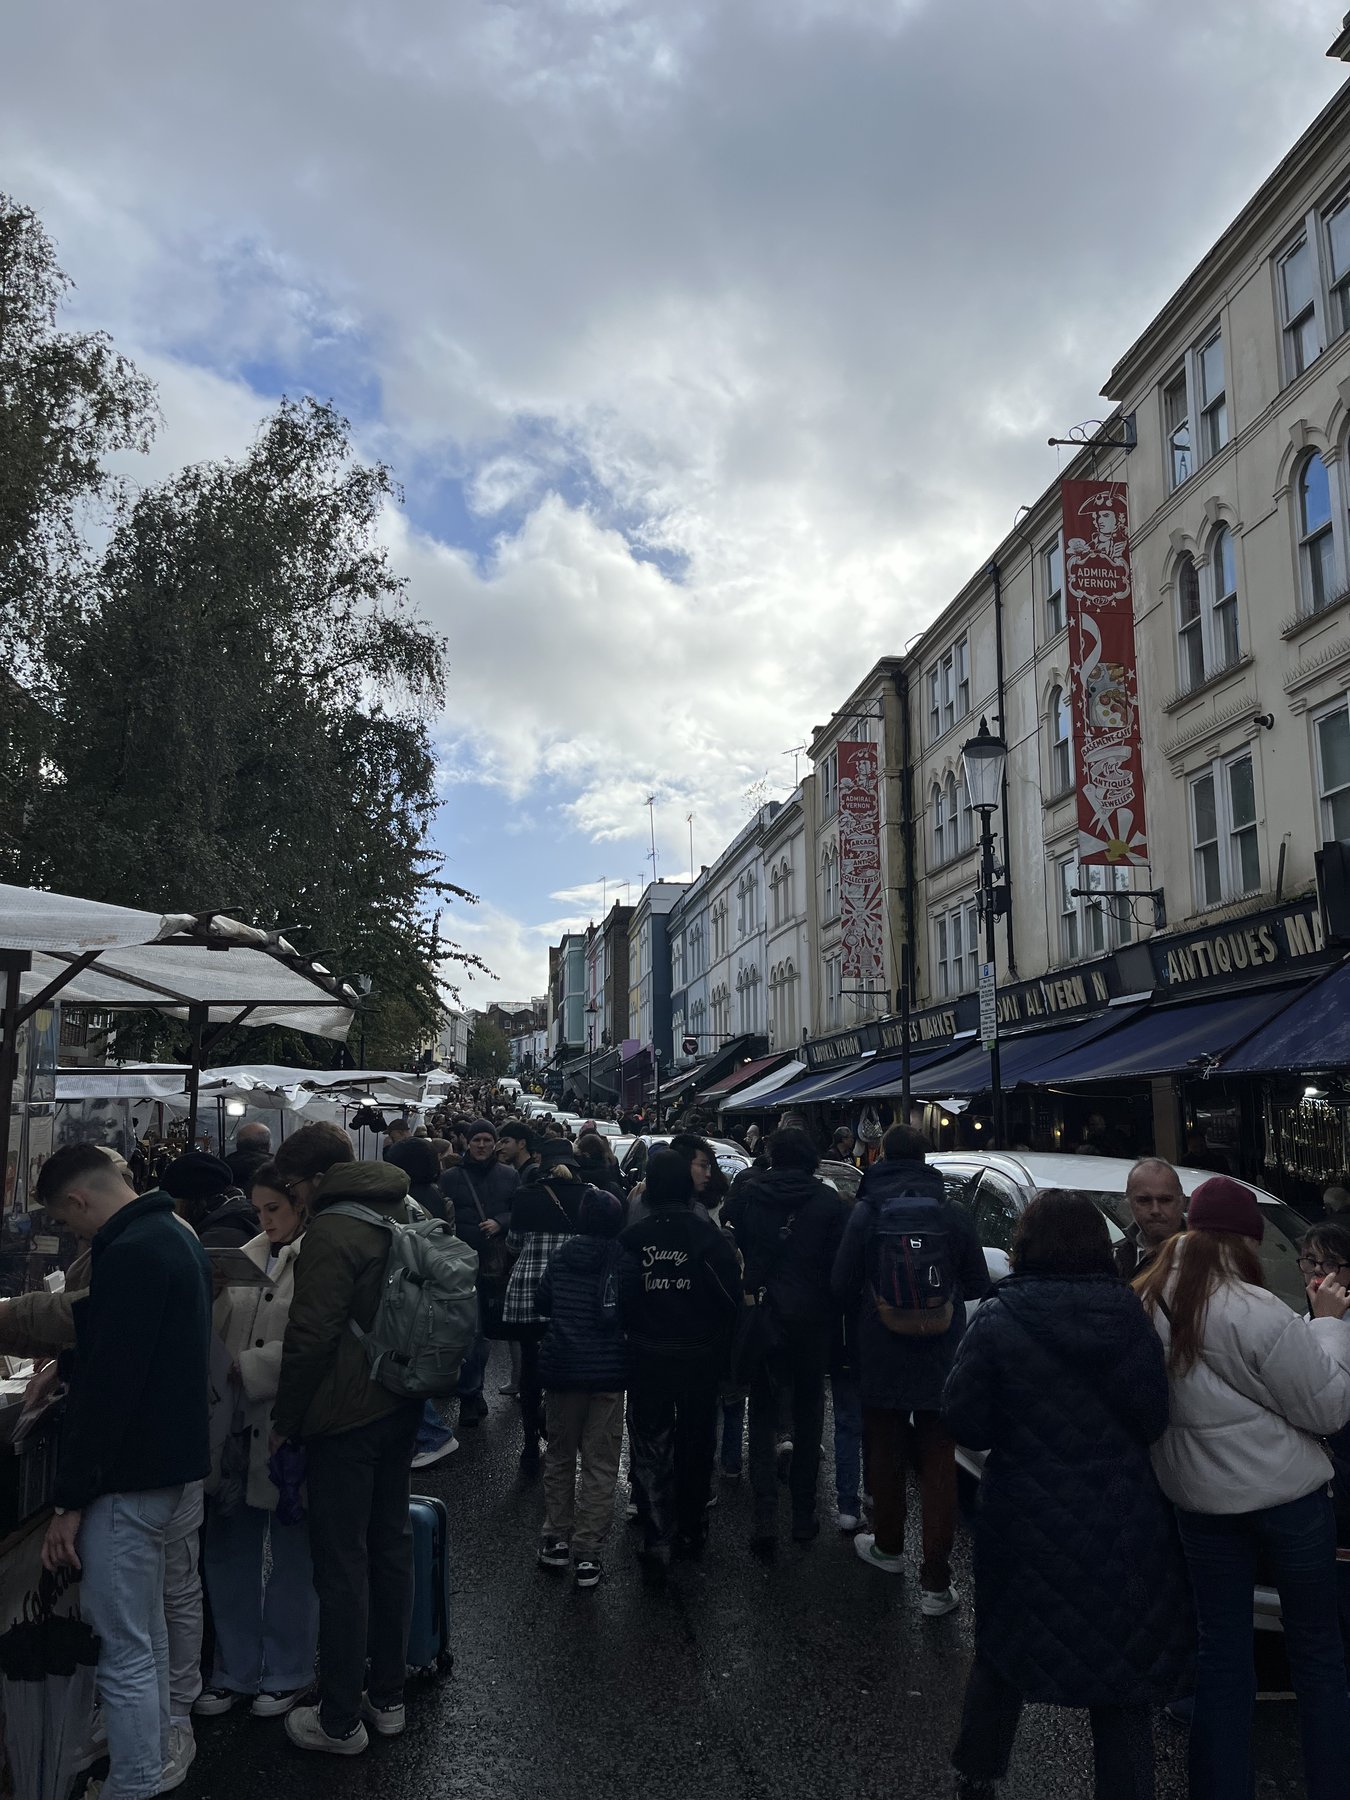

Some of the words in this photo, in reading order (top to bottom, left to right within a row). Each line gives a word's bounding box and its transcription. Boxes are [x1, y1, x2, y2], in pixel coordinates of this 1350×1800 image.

[1077, 567, 1120, 579] ADMIRAL
[1077, 578, 1117, 589] VERNON
[1082, 735, 1115, 756] BASEMENT
[1093, 777, 1131, 789] ANTIQUES
[1101, 791, 1134, 808] JEWELLERY
[846, 823, 872, 836] LARGEST
[851, 839, 876, 847] ARCADE
[842, 873, 879, 884] COLLECTABLES
[1167, 925, 1277, 985] ANTIQUES
[919, 1010, 958, 1041] MARKET
